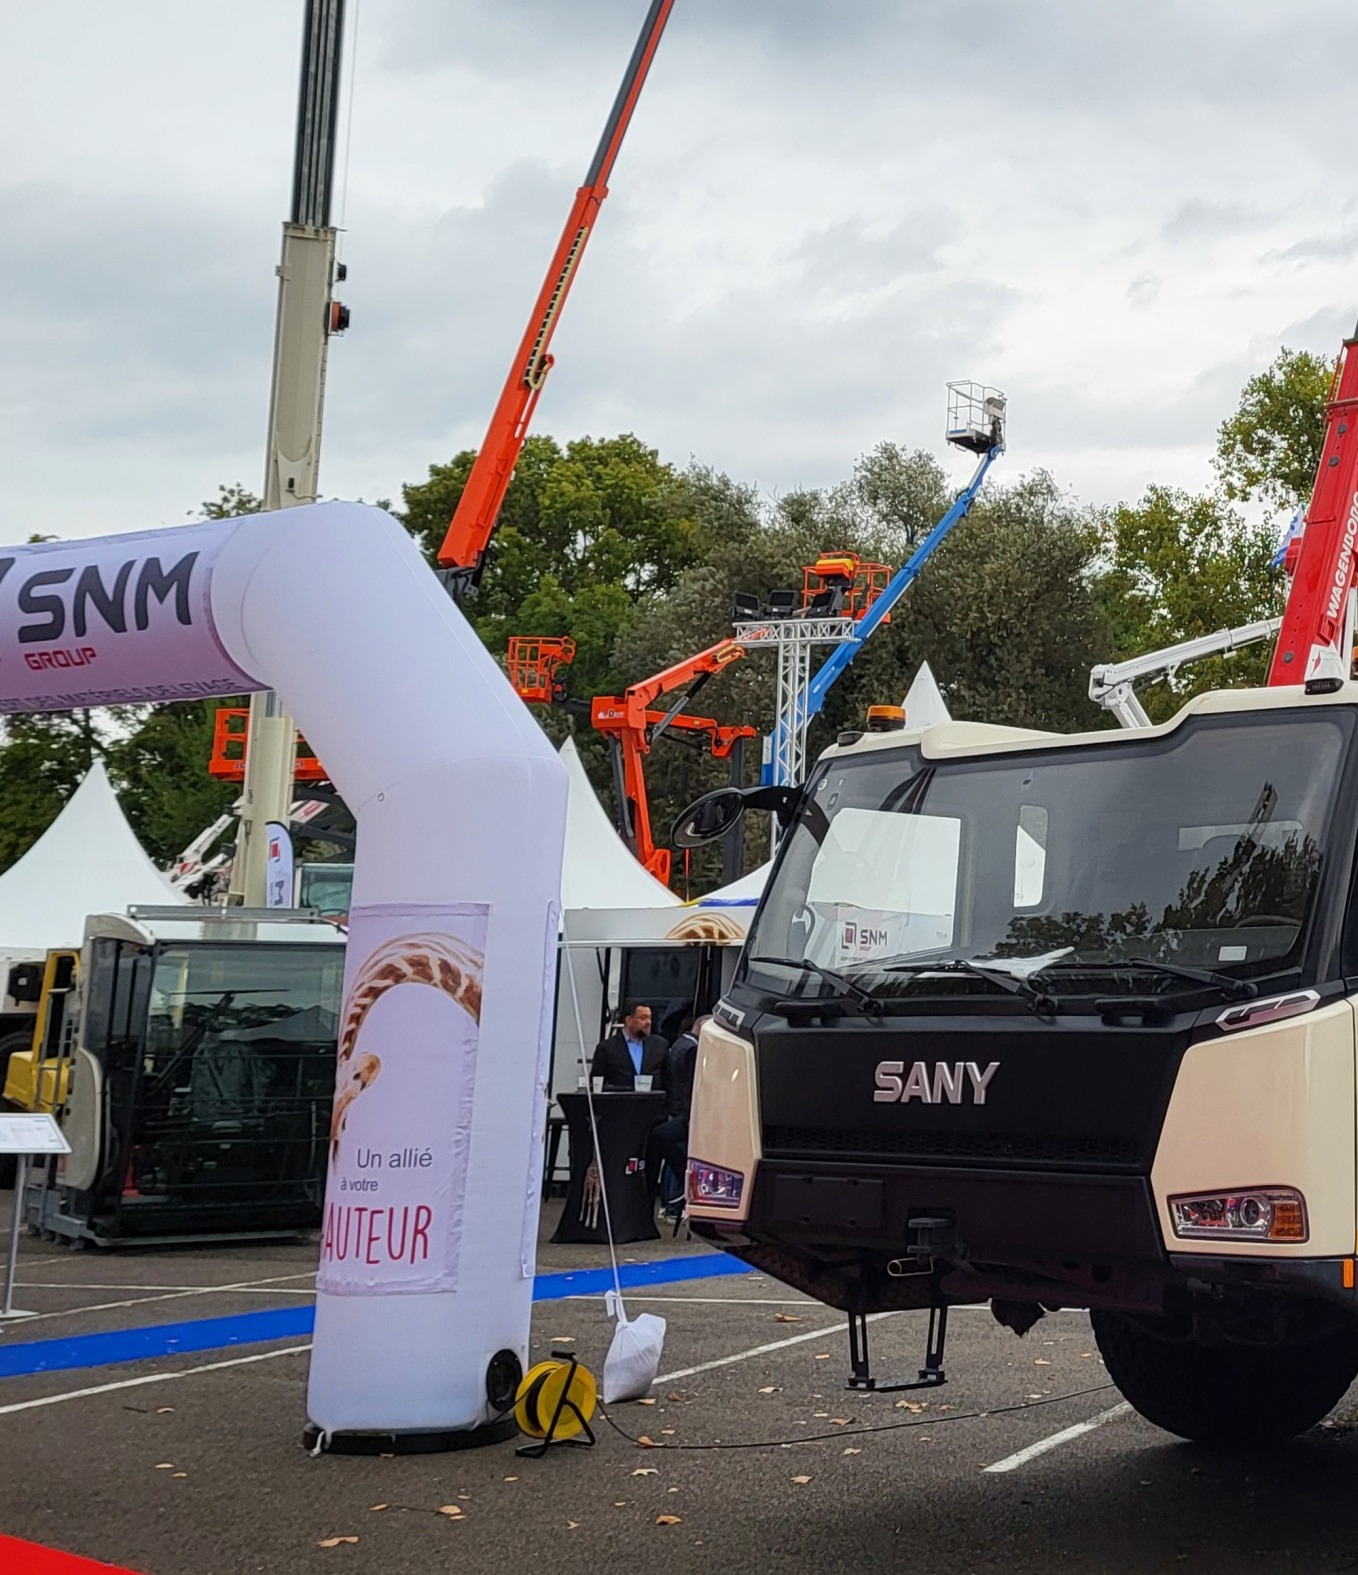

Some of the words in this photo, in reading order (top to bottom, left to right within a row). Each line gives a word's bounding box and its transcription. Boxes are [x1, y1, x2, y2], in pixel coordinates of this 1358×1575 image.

[17, 551, 201, 644] SNM
[24, 647, 97, 671] GROUP
[860, 929, 888, 946] SNM
[872, 1061, 1001, 1105] SANY
[357, 1148, 382, 1169] Un
[388, 1147, 433, 1168] allié
[340, 1177, 347, 1191] à
[350, 1178, 379, 1191] votre
[321, 1202, 433, 1265] AUTEUR
